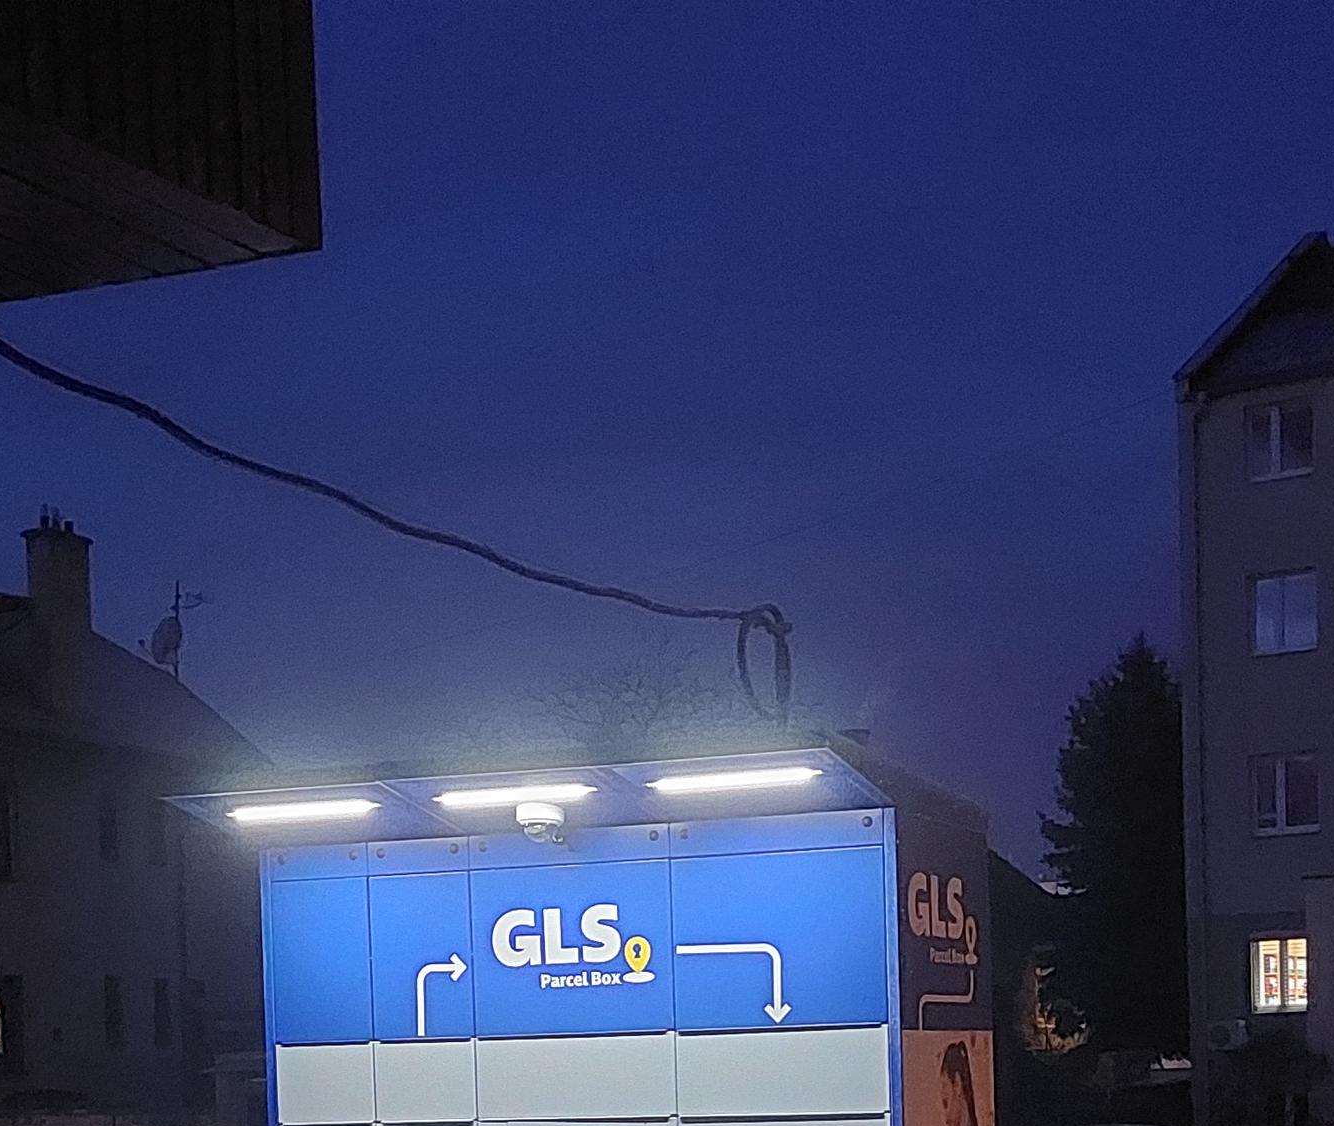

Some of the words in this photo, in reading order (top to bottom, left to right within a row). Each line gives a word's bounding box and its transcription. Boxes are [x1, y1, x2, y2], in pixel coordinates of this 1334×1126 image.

[491, 903, 622, 968] GLS
[907, 871, 964, 940] GLS
[540, 971, 589, 989] Parcel
[591, 971, 622, 986] Box
